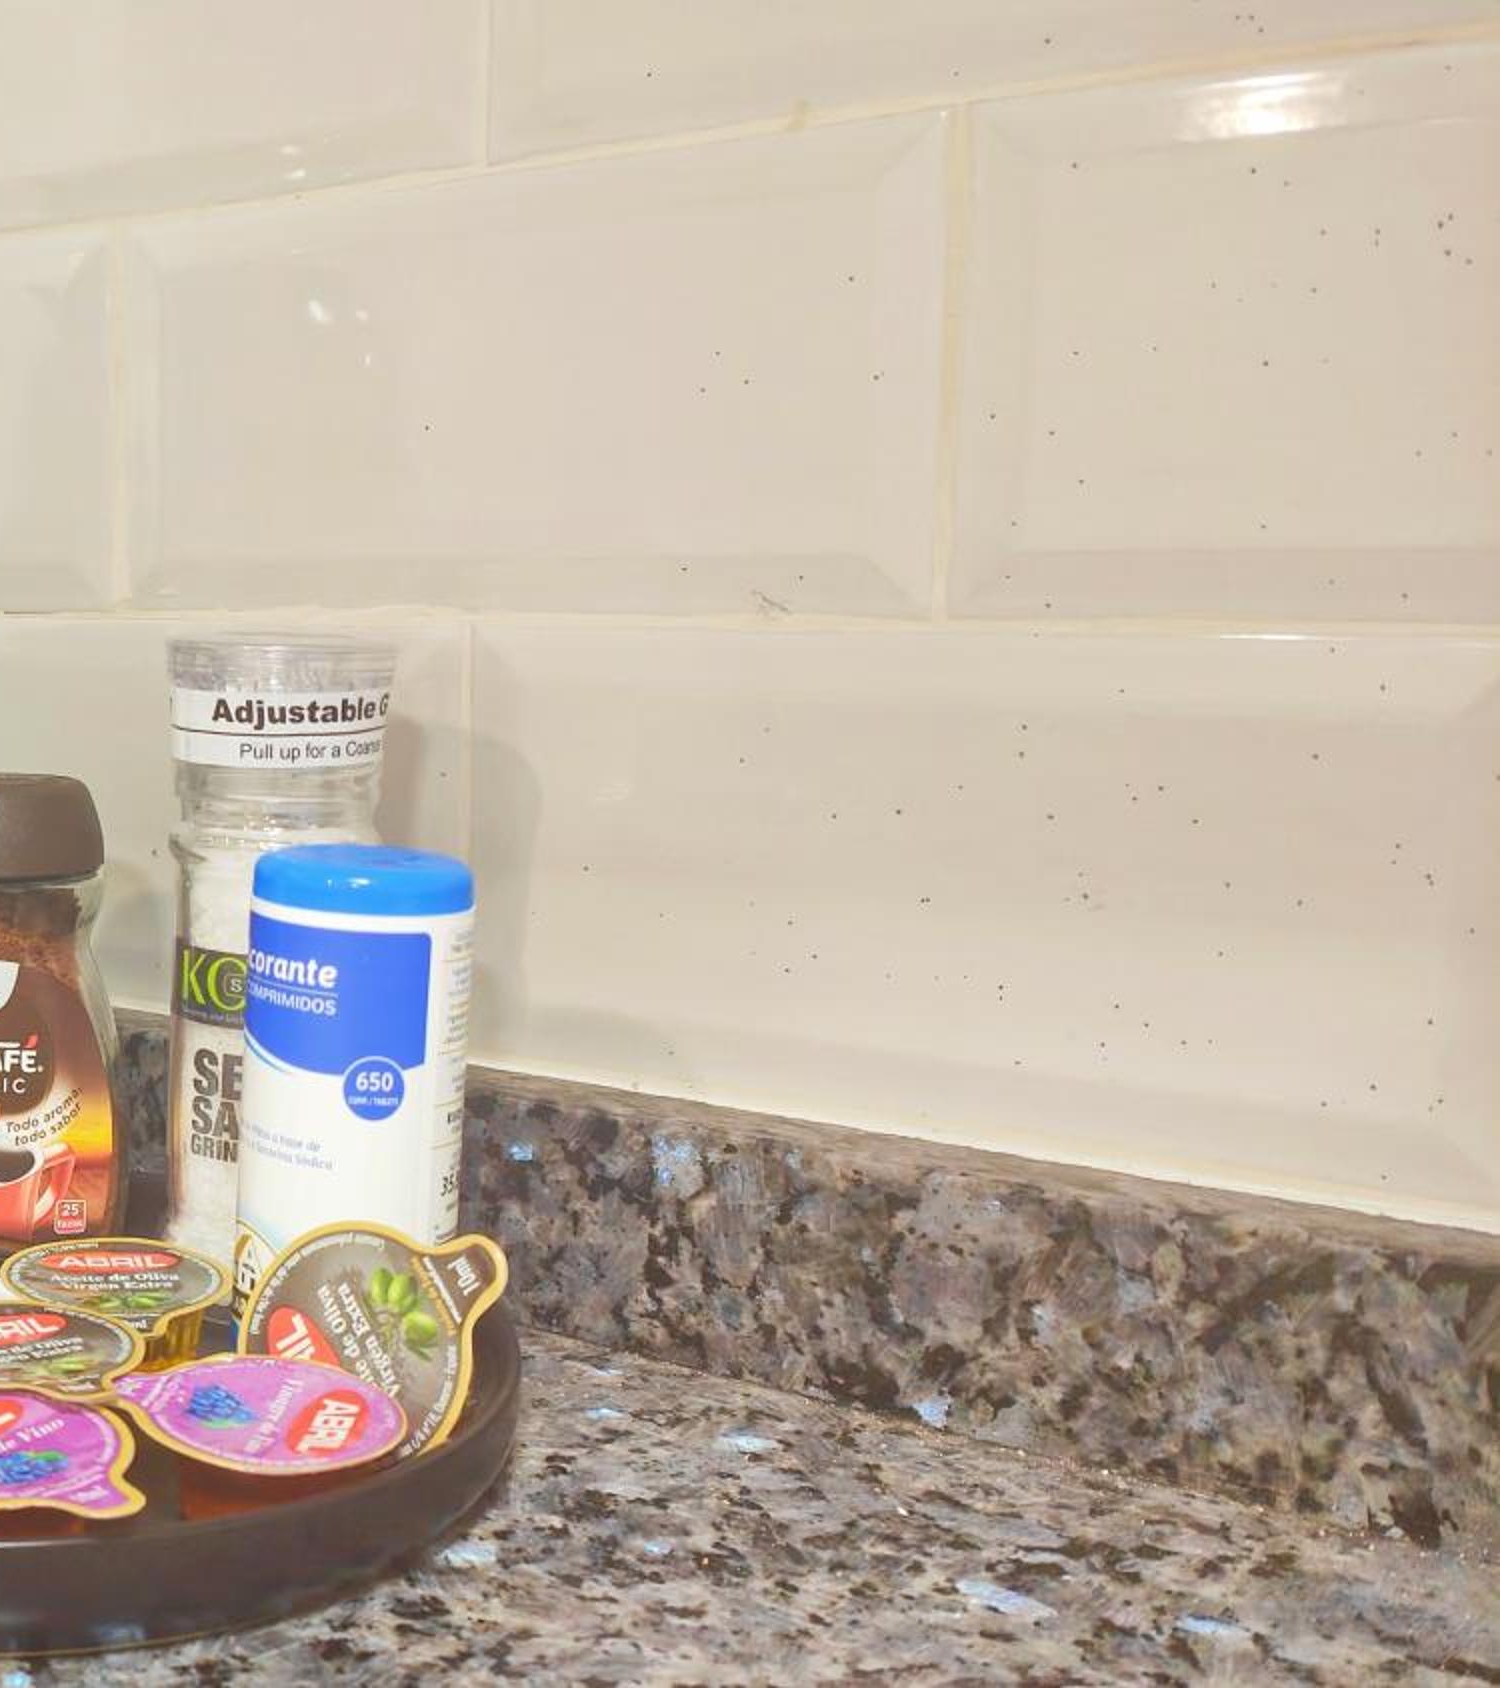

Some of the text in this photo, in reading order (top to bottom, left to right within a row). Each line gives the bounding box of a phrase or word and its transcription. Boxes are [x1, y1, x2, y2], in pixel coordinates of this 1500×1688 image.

[212, 696, 376, 731] Adjustable
[239, 742, 274, 760] Pull
[279, 744, 301, 764] up
[305, 741, 327, 758] for
[331, 744, 342, 758] a
[355, 1071, 395, 1092] 650
[6, 1117, 40, 1134] Todo
[15, 1102, 82, 1147] todo sabor
[62, 1202, 80, 1217] 25
[317, 1284, 348, 1335] Oliva
[16, 1417, 66, 1445] Vino
